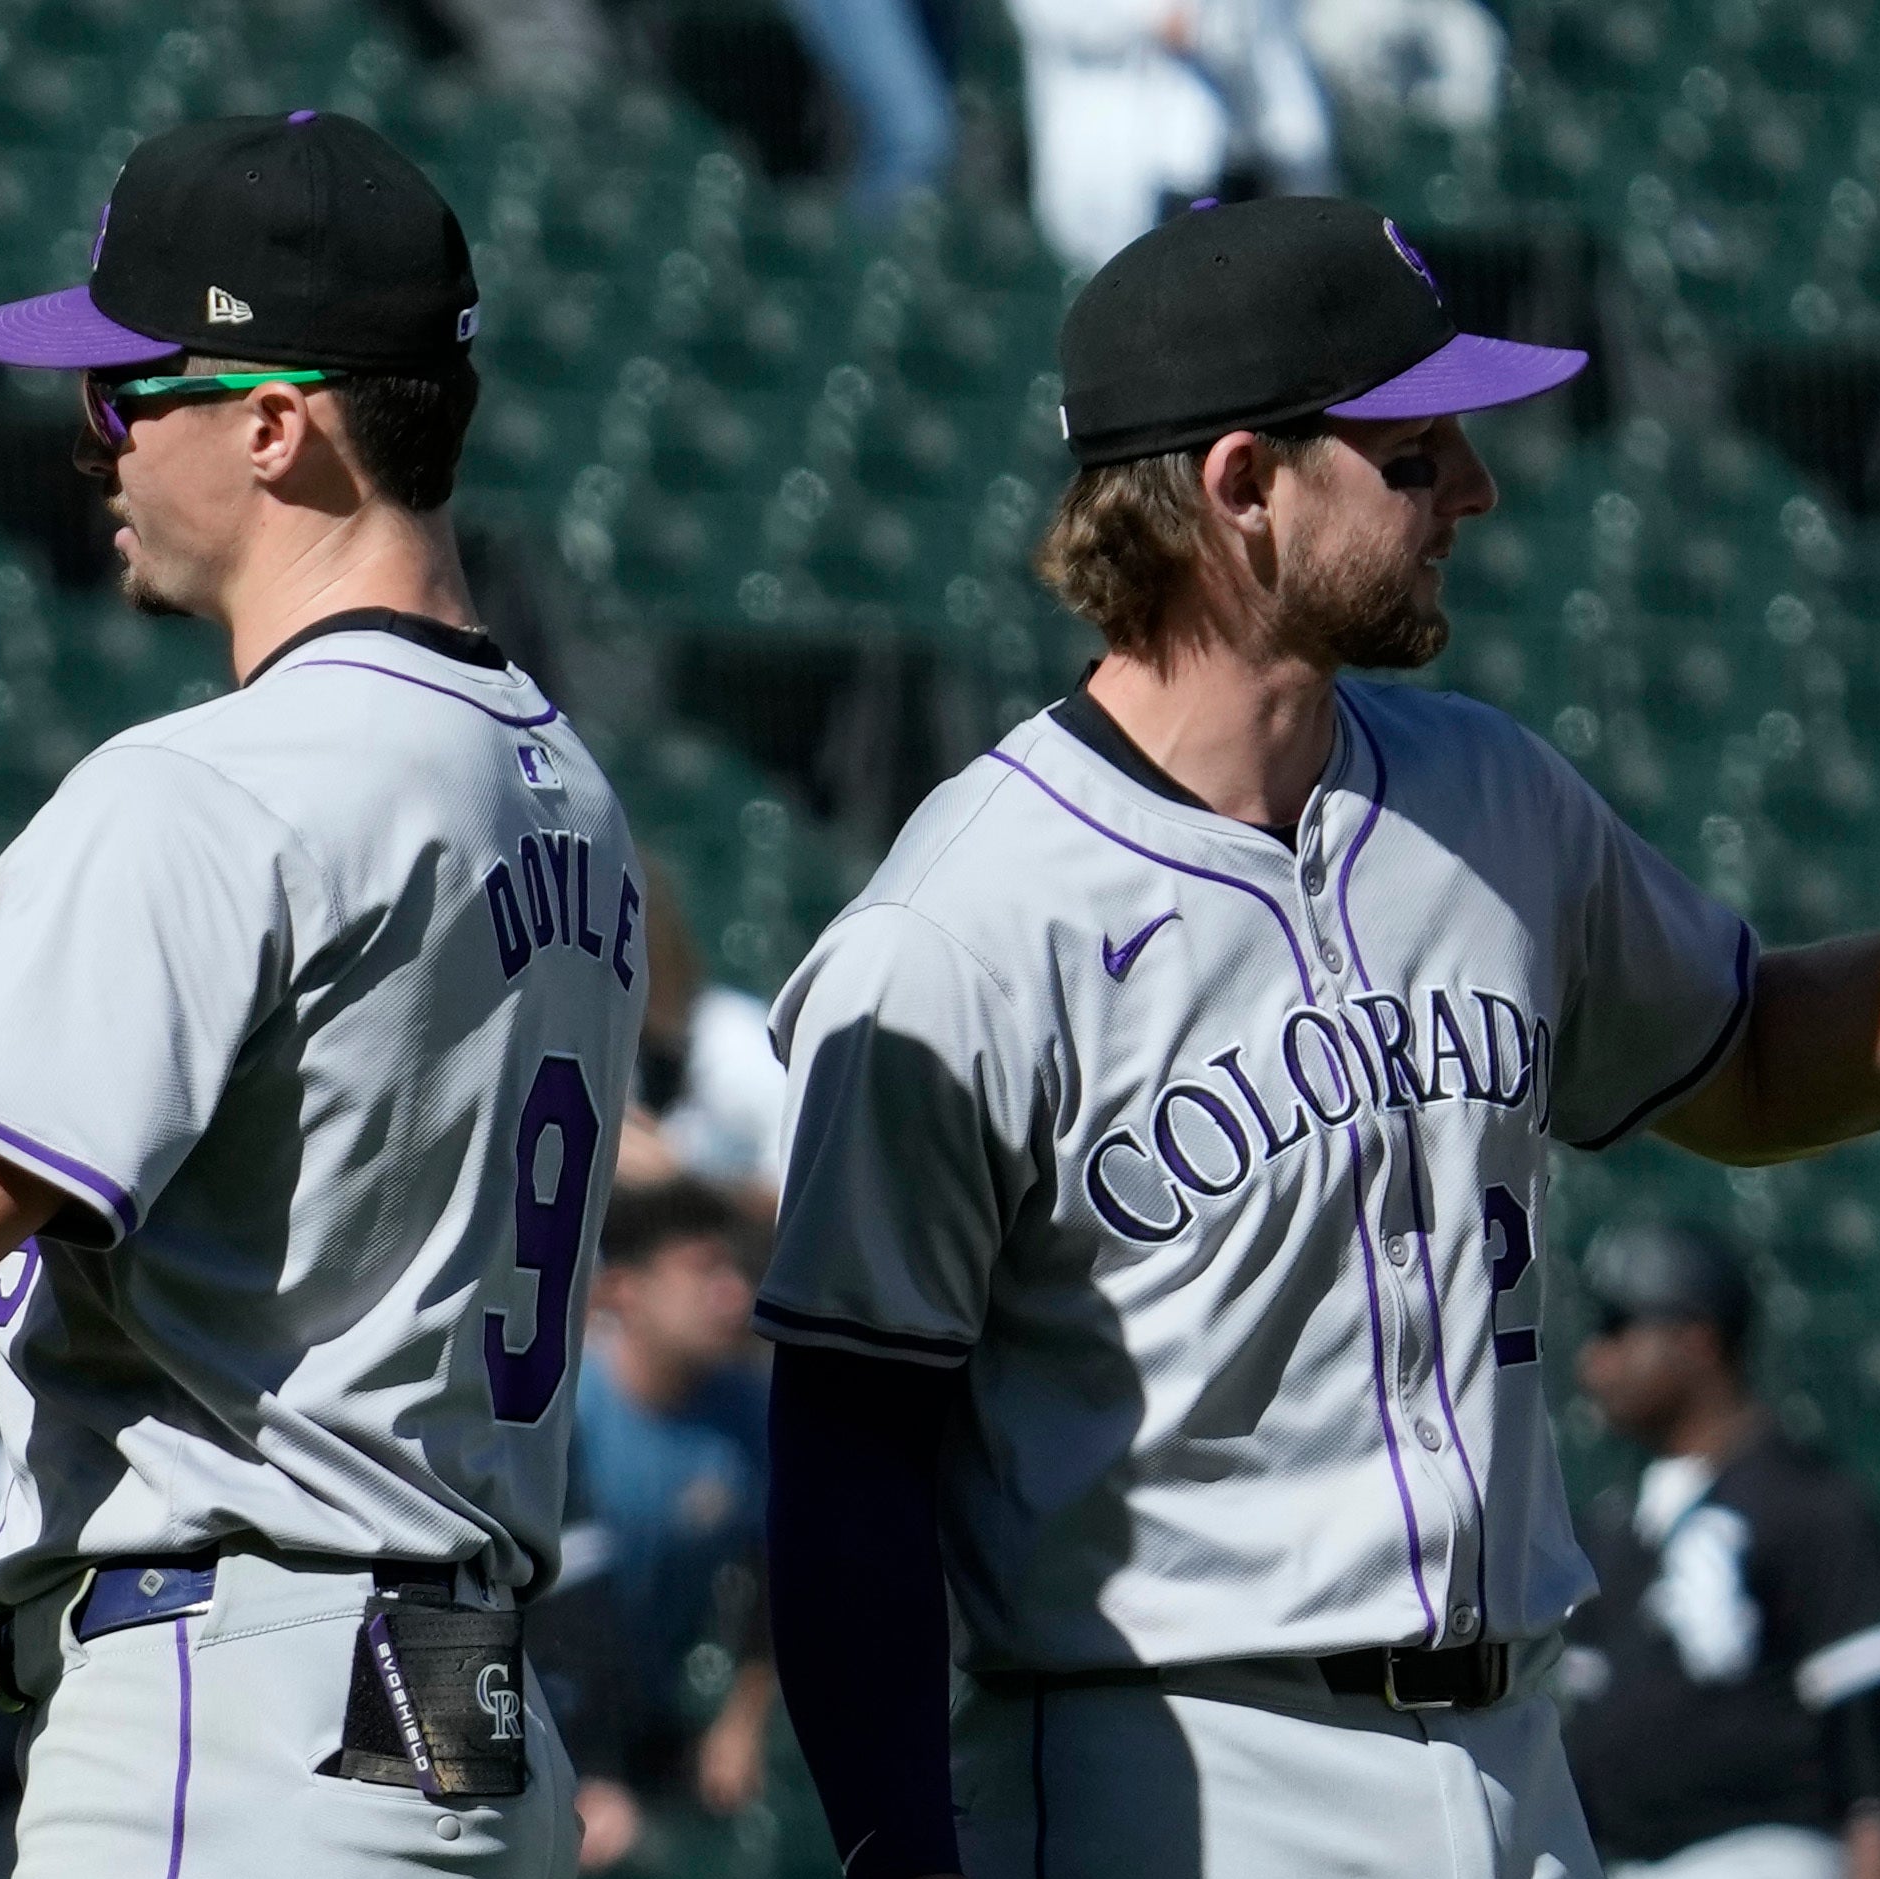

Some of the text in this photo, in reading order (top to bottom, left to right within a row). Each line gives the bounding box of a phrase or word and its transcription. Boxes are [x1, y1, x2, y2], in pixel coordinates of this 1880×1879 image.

[484, 827, 641, 994] DOYLE
[1083, 984, 1551, 1247] COLORADO
[483, 1050, 602, 1428] 9
[377, 1642, 429, 1772] EVOSHIELD
[476, 1663, 524, 1740] CR
